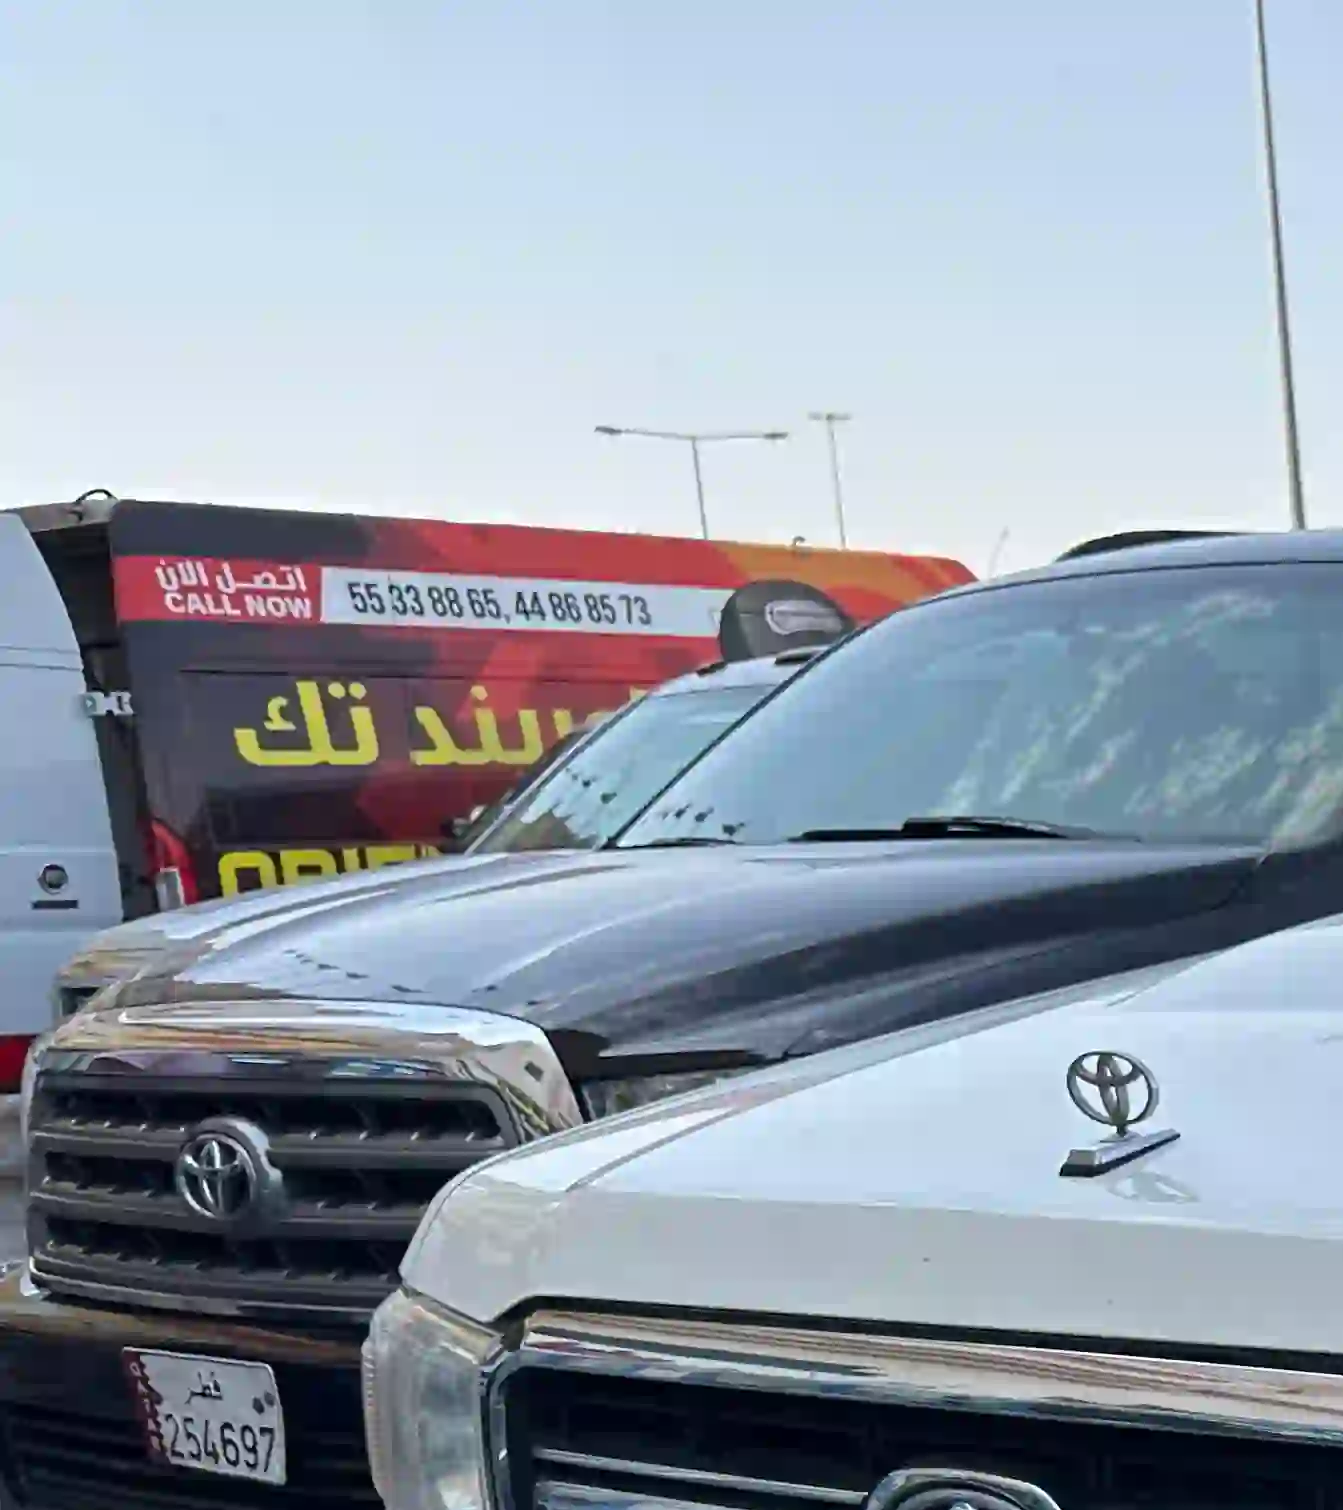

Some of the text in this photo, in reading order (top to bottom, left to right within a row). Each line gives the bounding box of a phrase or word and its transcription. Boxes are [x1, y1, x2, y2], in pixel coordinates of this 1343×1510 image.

[164, 591, 312, 619] CALL NOW
[347, 582, 386, 614] 55
[388, 584, 424, 616] 33
[427, 586, 464, 618] 88
[515, 591, 546, 621] 44
[549, 592, 582, 623] 86
[583, 594, 617, 625] 85
[618, 594, 652, 626] 73
[233, 681, 380, 766] تك
[184, 1371, 223, 1405] قطر
[164, 1413, 276, 1473] 254697
